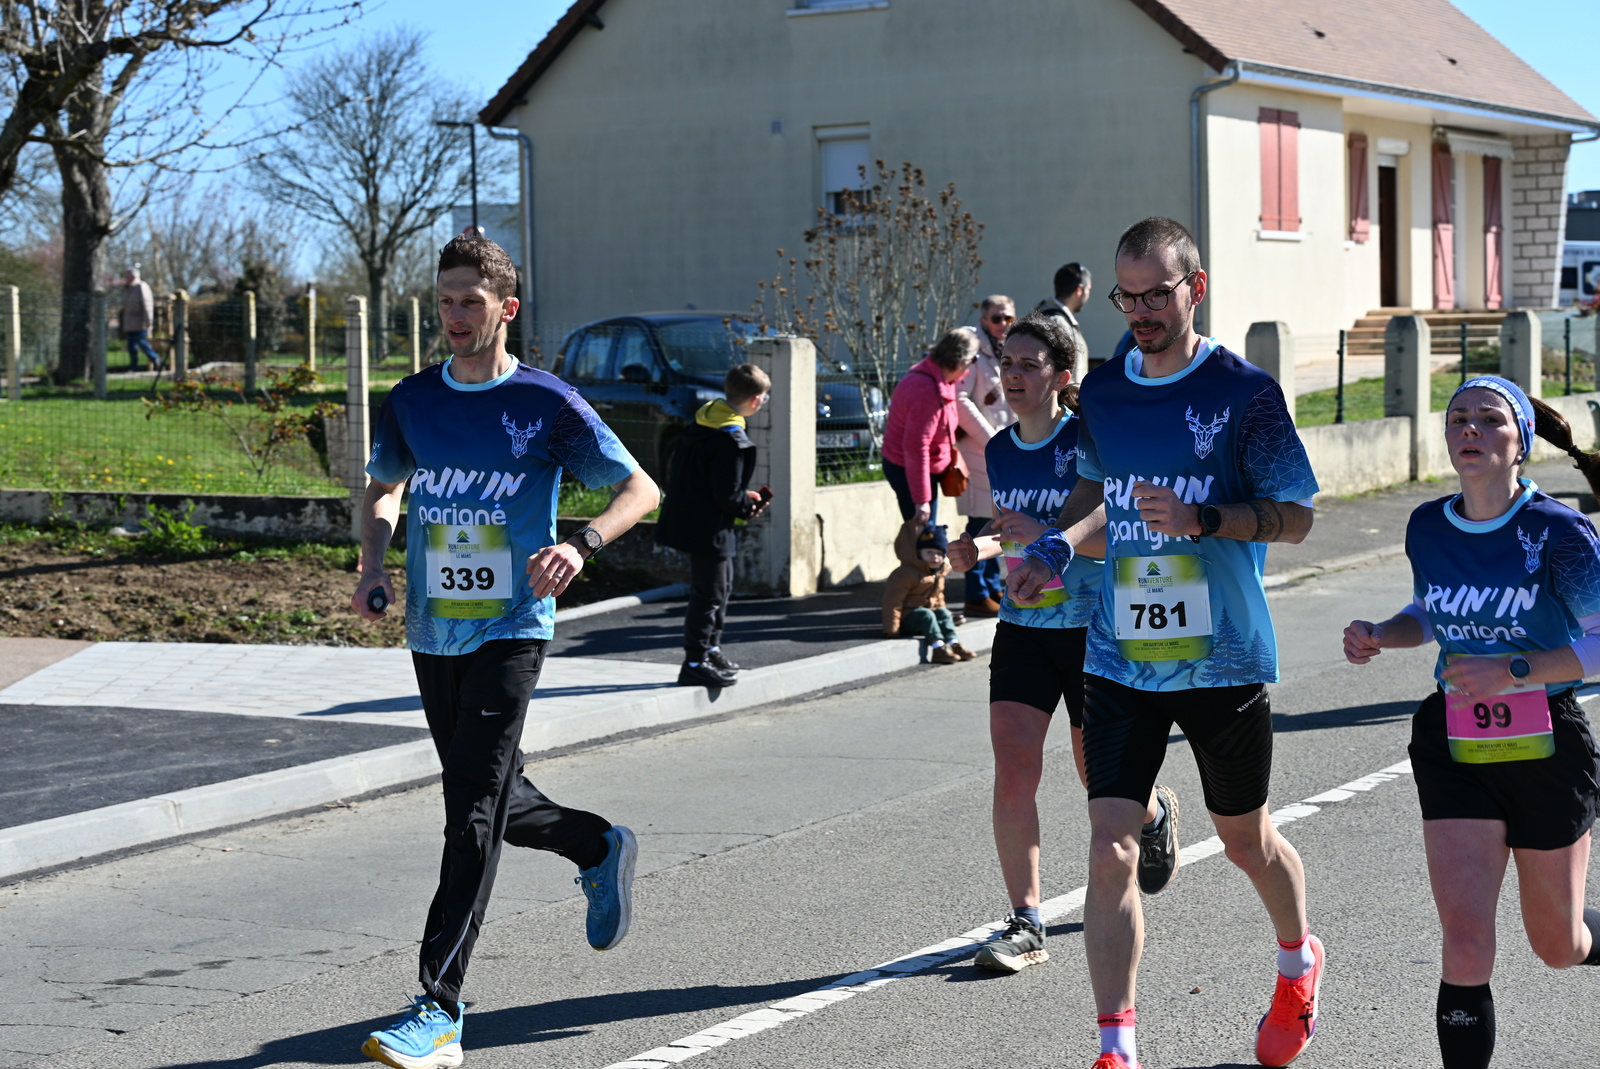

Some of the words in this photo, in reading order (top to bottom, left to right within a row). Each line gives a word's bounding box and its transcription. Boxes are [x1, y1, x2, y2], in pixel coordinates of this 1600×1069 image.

[409, 466, 527, 502] RUN'IN
[1103, 473, 1215, 511] RU'IN
[1109, 520, 1193, 551] parig
[440, 566, 495, 592] 339
[1129, 600, 1187, 630] 781
[1424, 583, 1540, 619] RUN'IN
[1473, 702, 1512, 729] 99
